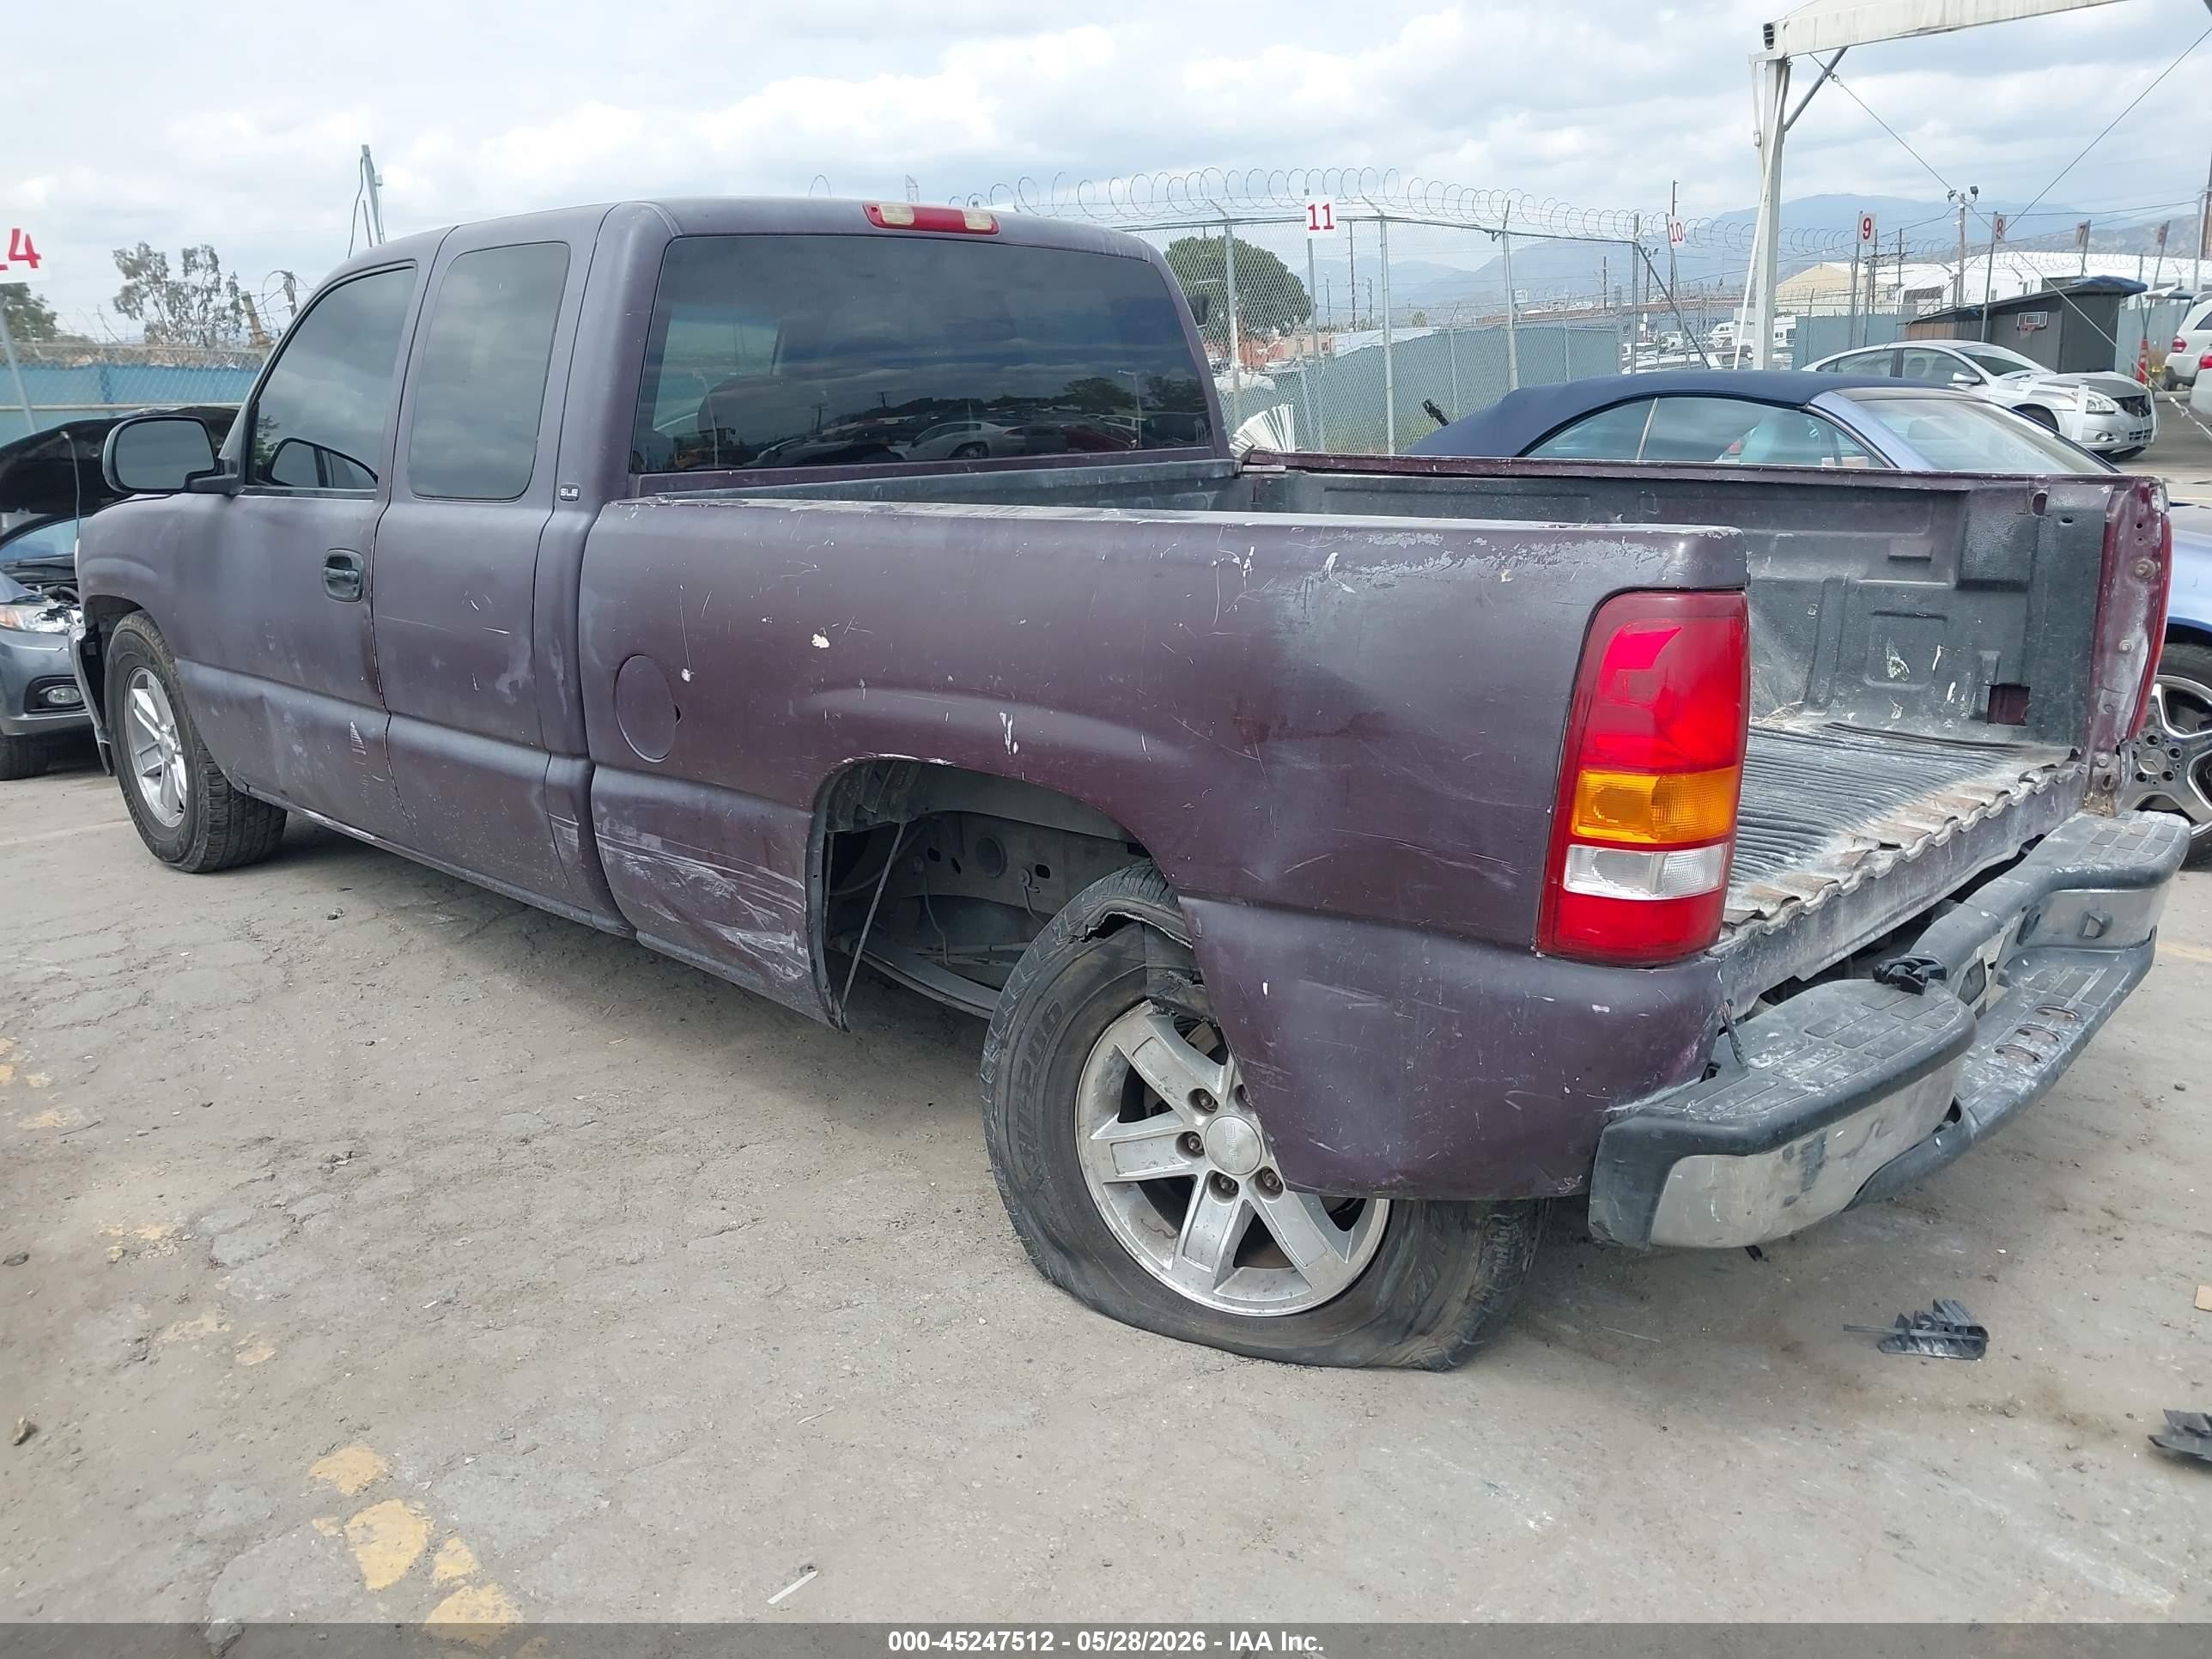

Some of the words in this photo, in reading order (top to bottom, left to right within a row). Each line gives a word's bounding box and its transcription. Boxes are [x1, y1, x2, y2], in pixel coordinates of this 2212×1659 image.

[1308, 203, 1334, 230] 11
[1670, 222, 1683, 242] 10
[1863, 217, 1872, 240] 9
[1996, 218, 2003, 240] 8
[2078, 224, 2087, 245] 7
[0, 228, 41, 270] 4
[560, 488, 579, 497] SLE
